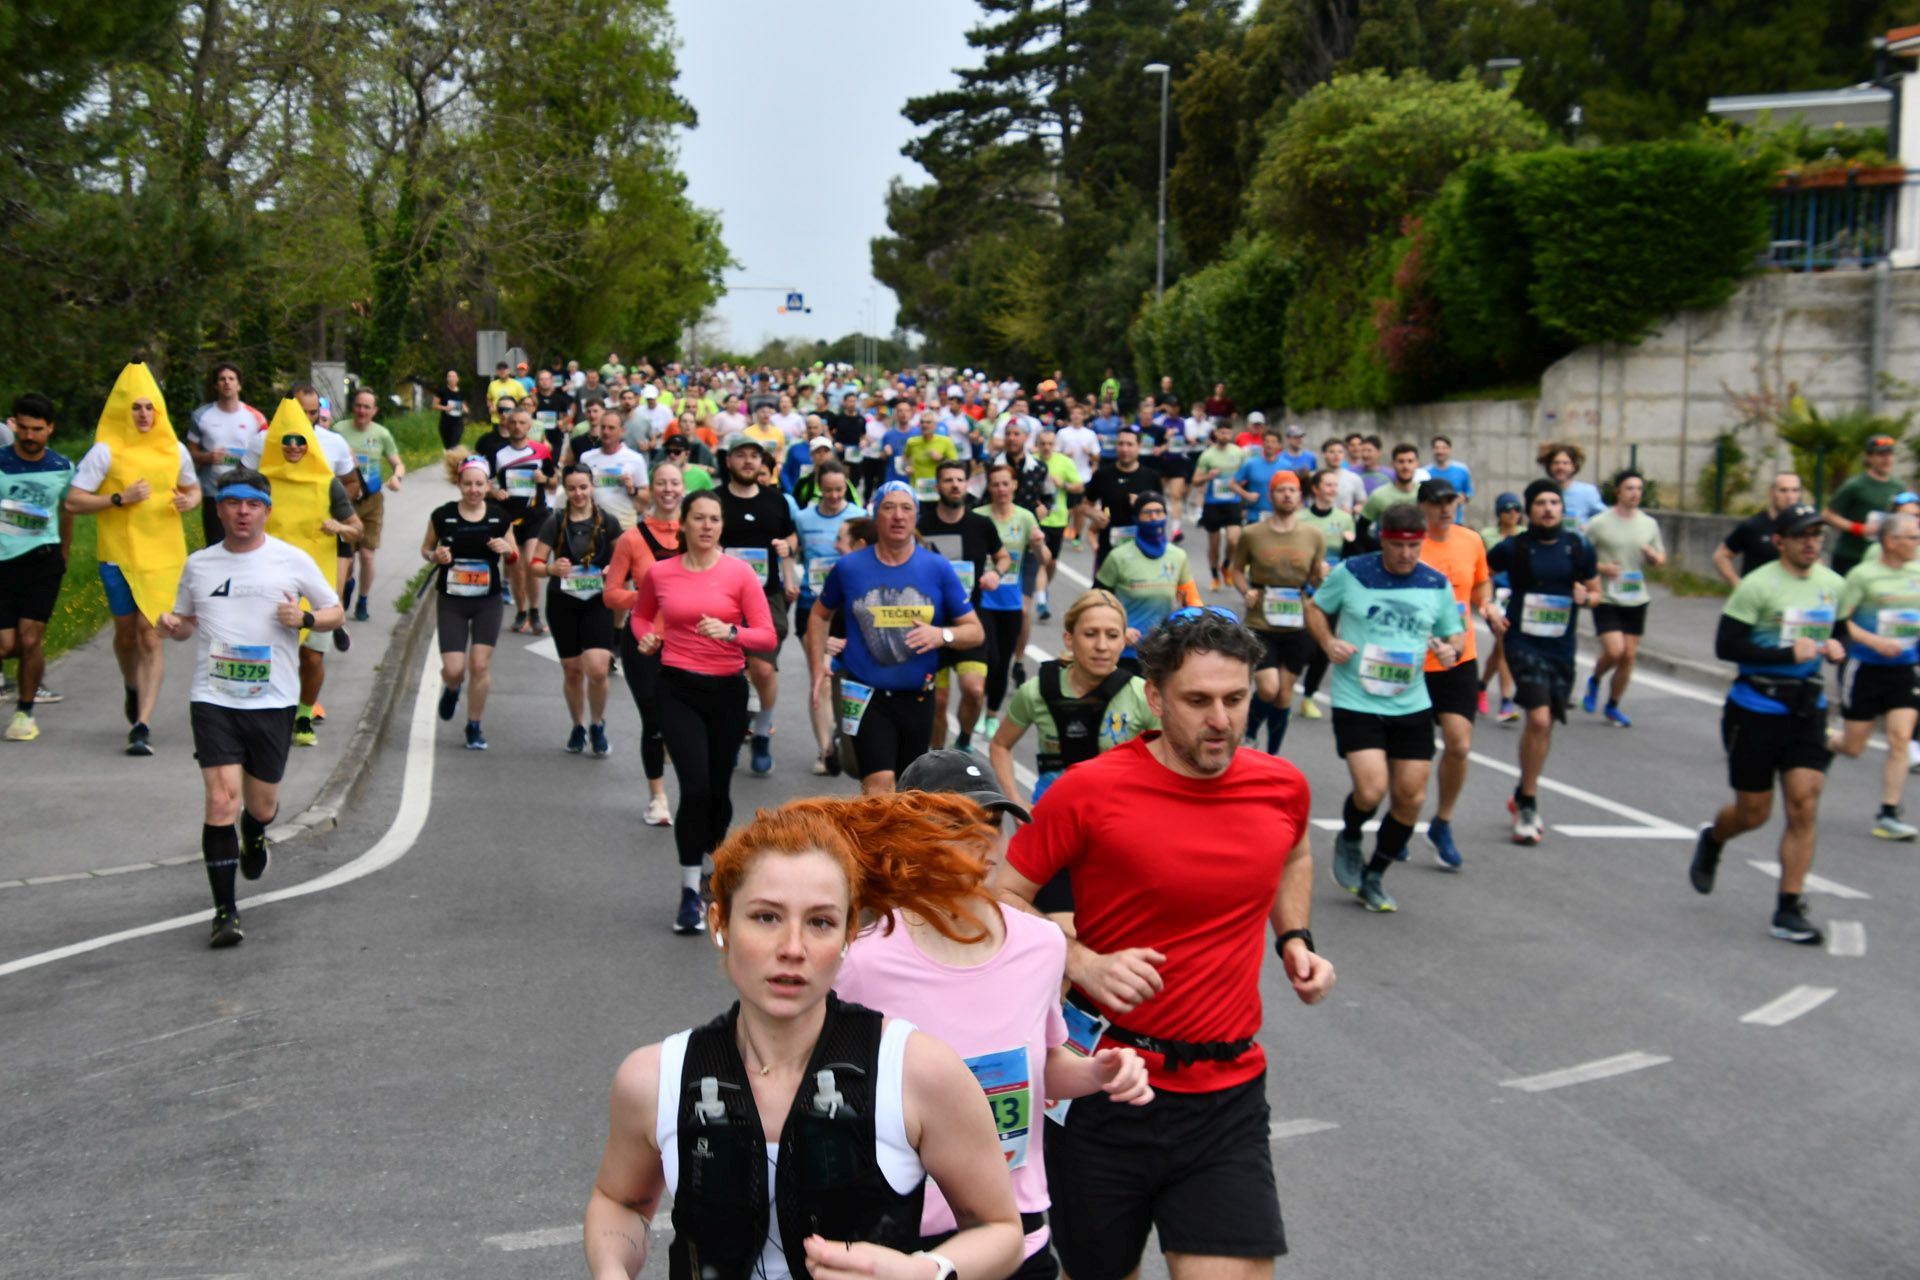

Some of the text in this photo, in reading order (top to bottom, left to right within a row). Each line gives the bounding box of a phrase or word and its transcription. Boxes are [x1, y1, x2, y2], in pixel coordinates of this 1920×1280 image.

[467, 574, 480, 582] 17
[881, 608, 921, 618] TEČEM
[228, 664, 267, 679] 1579
